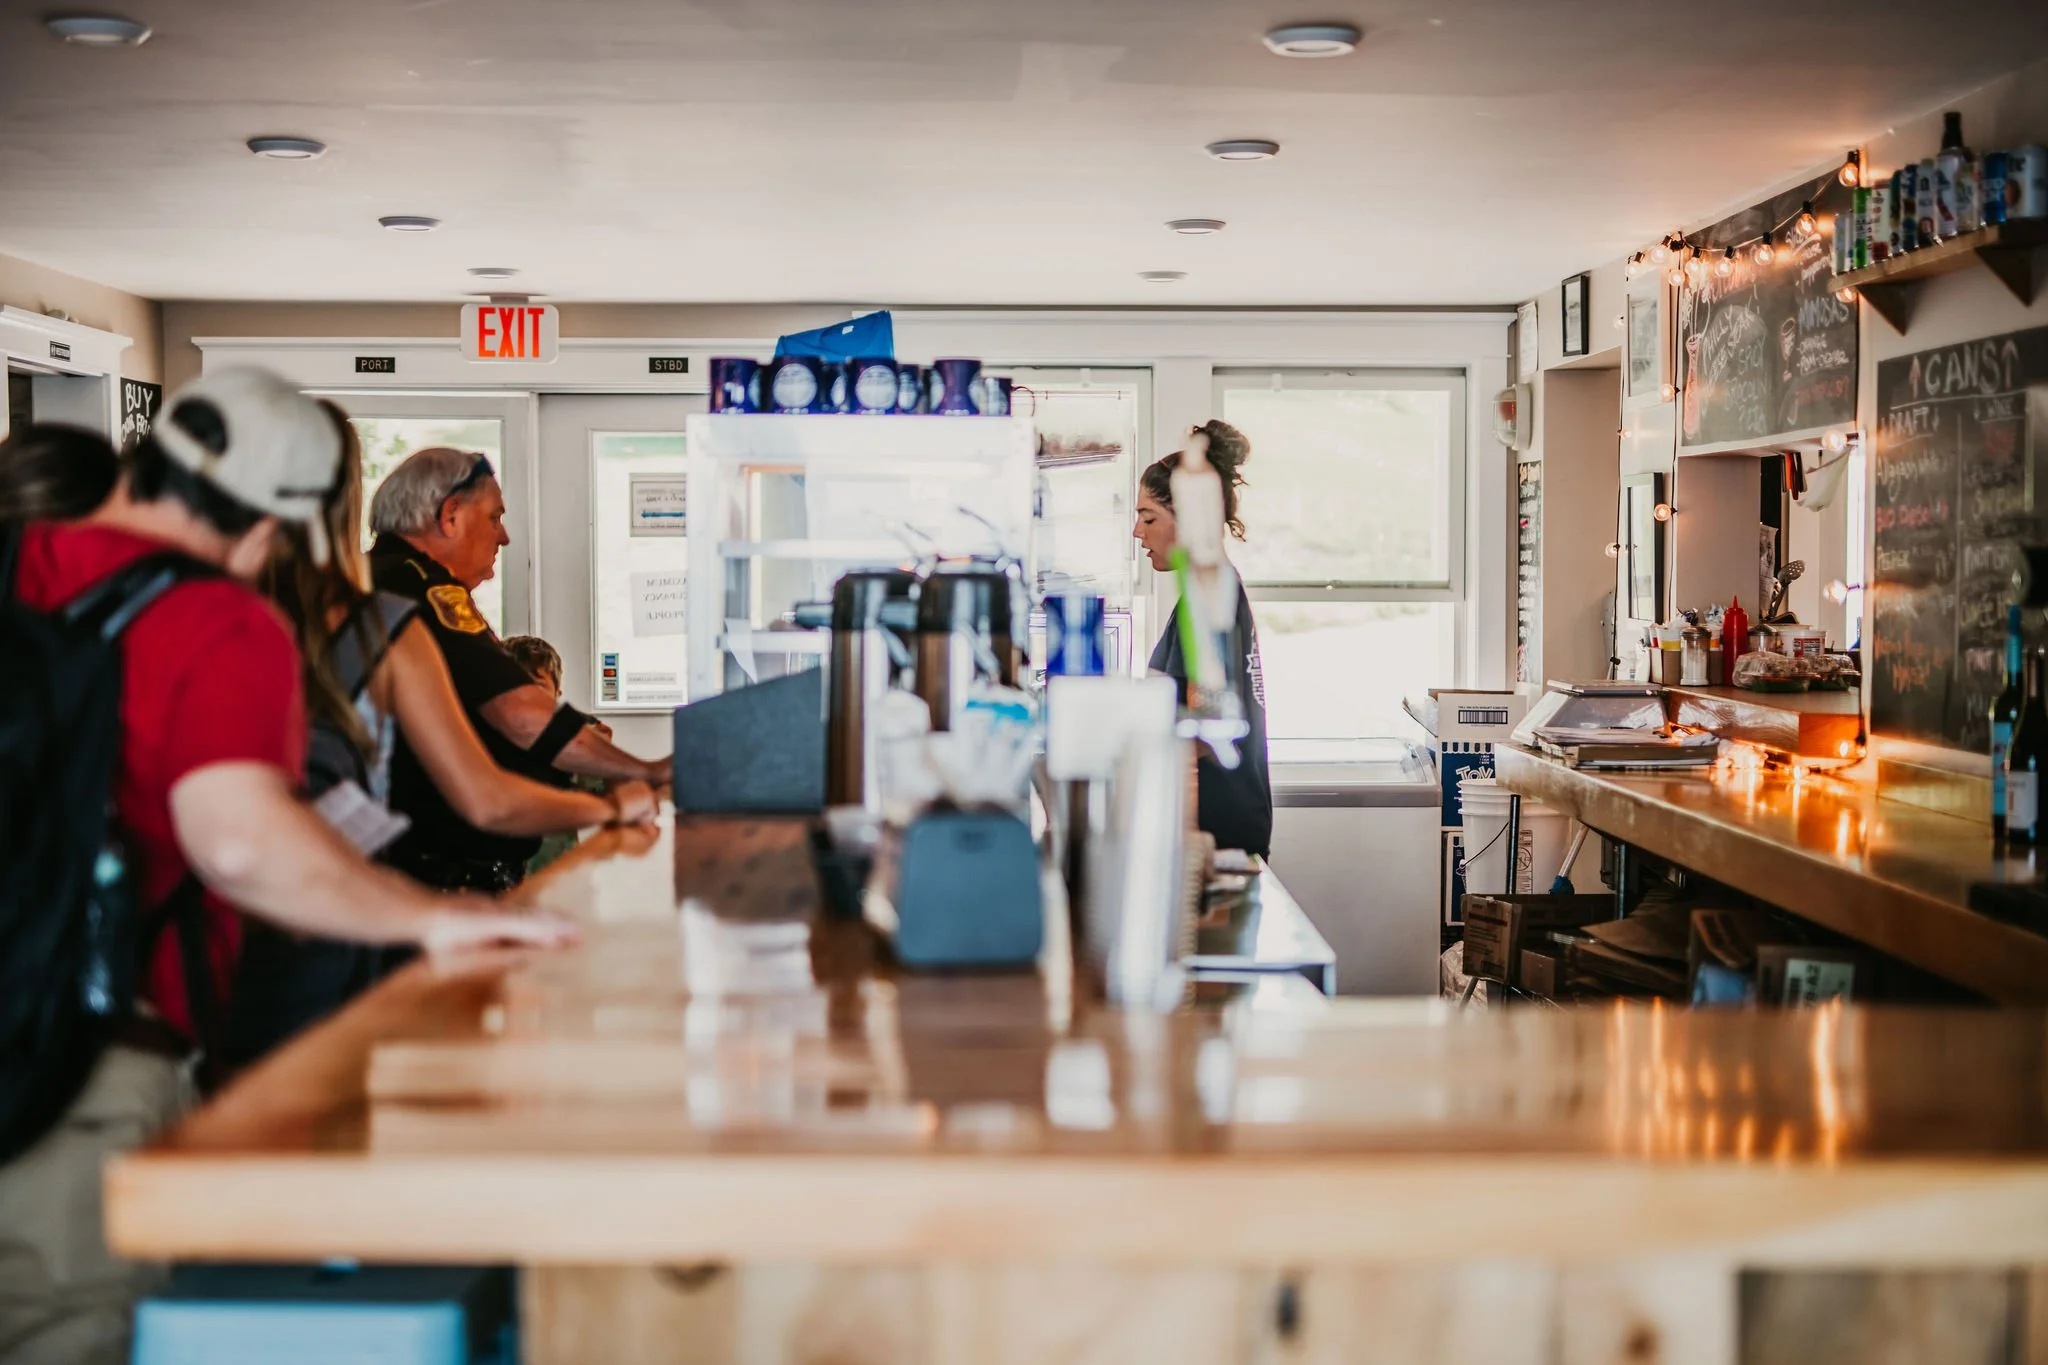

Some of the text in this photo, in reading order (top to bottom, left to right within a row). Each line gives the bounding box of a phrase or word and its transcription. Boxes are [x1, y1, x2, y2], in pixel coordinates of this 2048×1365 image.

[478, 307, 545, 358] EXIT
[1799, 297, 1850, 335] MIMOSAS
[361, 360, 389, 370] PORT
[654, 360, 683, 371] STBD
[1924, 339, 2001, 395] CANS
[125, 382, 153, 418] BUY
[1889, 406, 1930, 437] DRAFT
